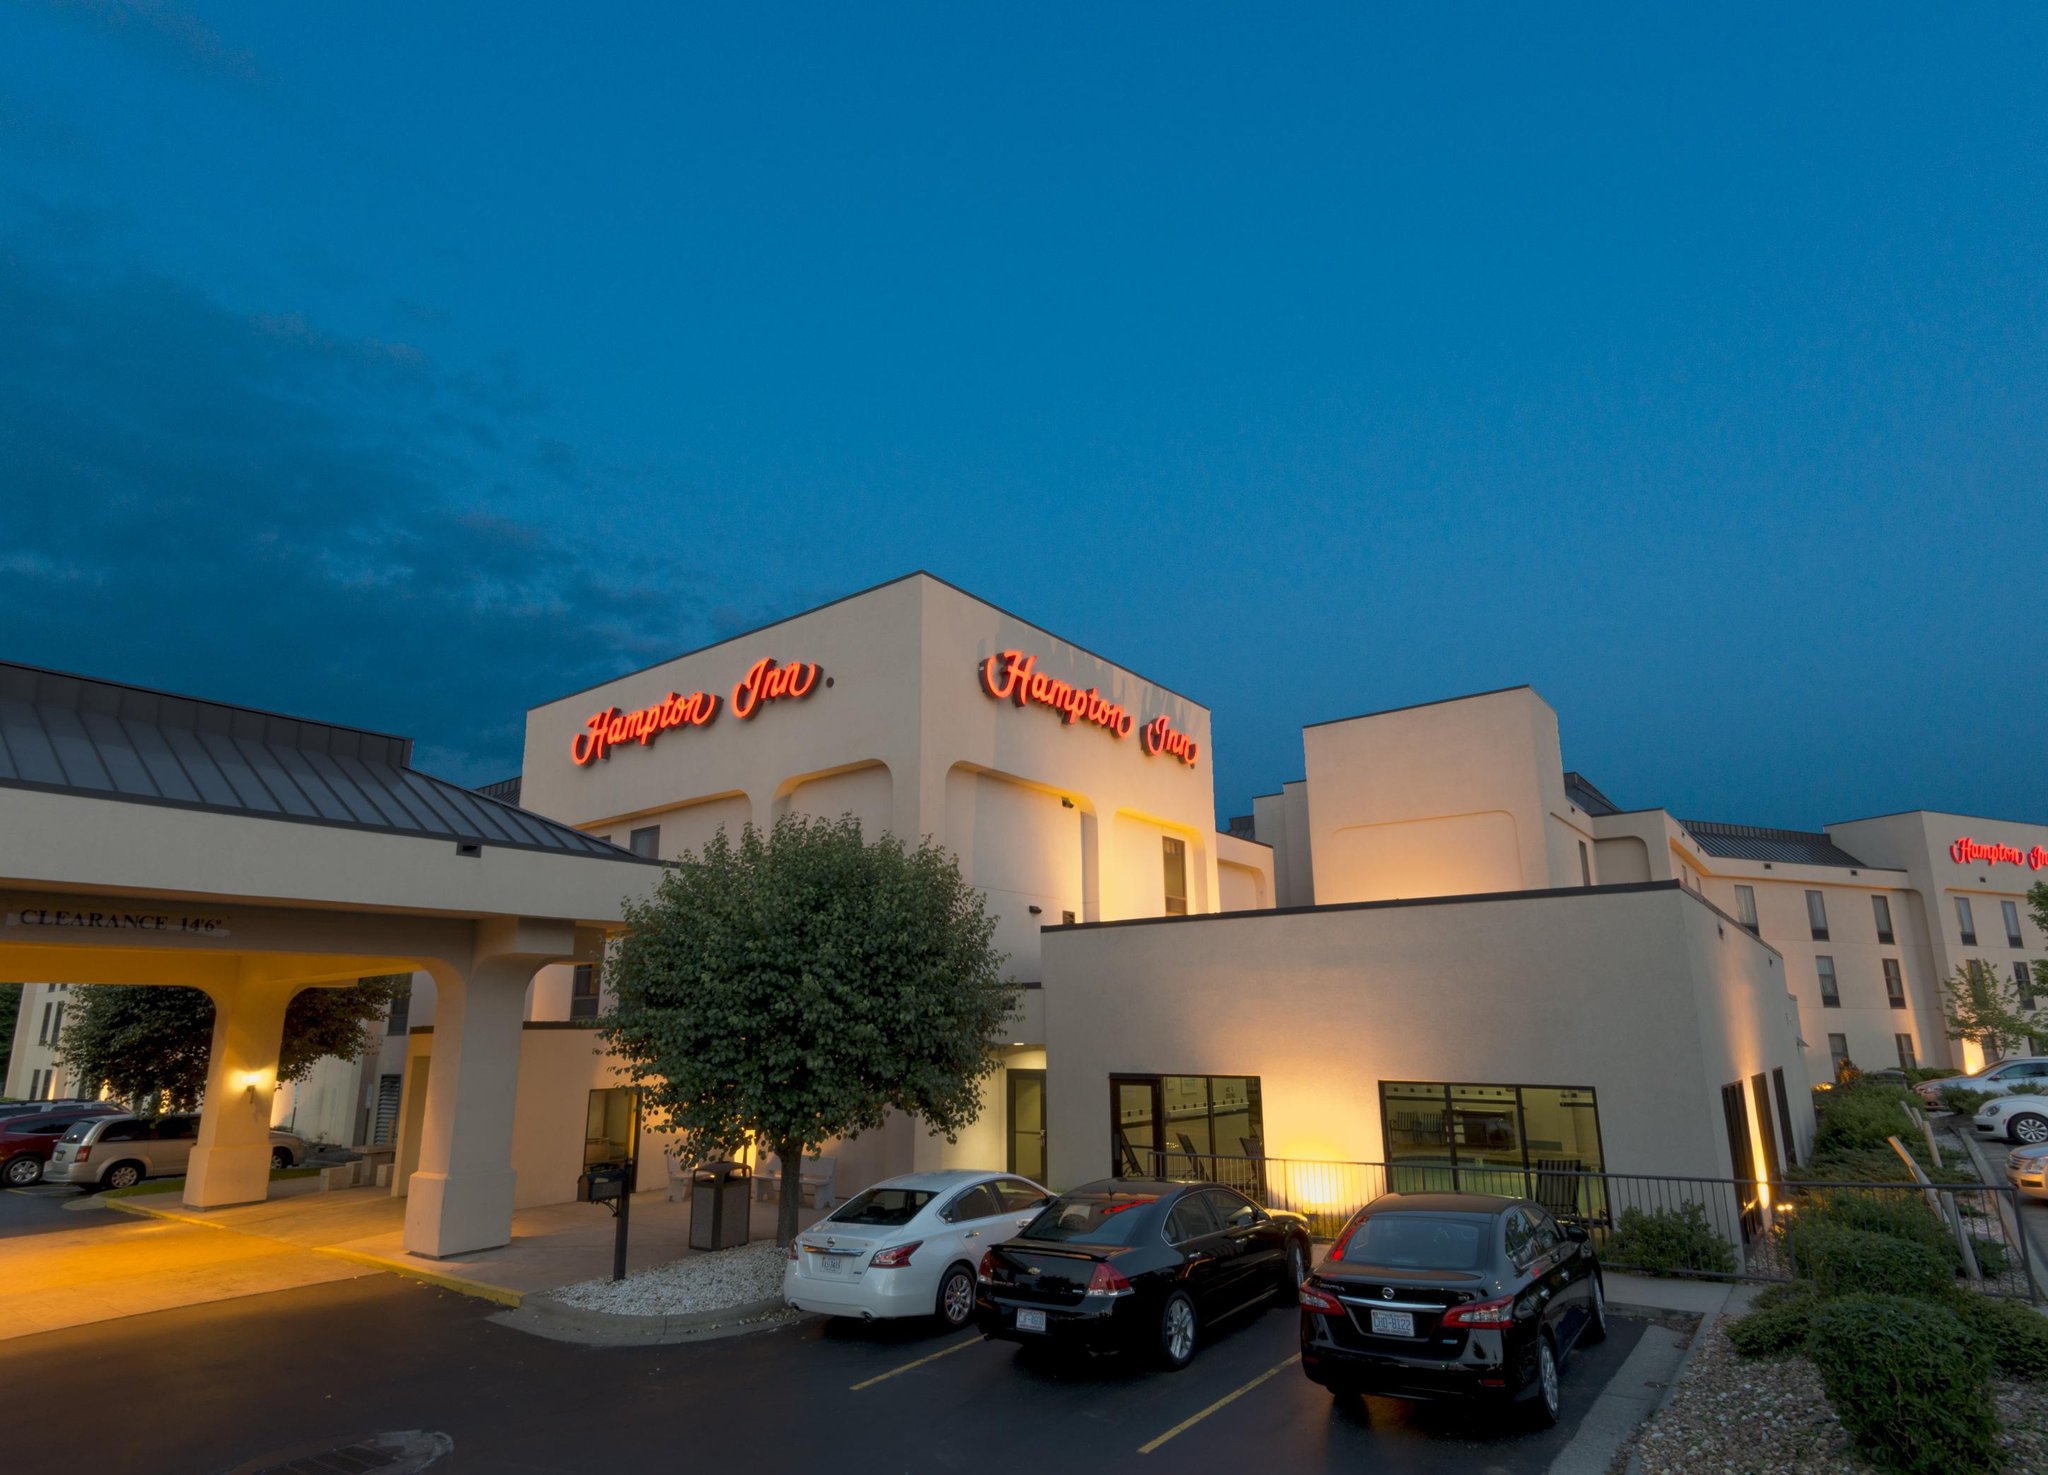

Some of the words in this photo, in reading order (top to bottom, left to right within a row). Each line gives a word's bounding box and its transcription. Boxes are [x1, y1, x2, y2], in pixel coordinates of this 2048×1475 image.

[571, 692, 724, 767] Hampton
[731, 657, 822, 719] Inn
[980, 649, 1134, 738] Hampton
[1142, 715, 1200, 765] Inn
[1950, 836, 2026, 866] Hampton
[19, 908, 170, 931] CLEARANCE
